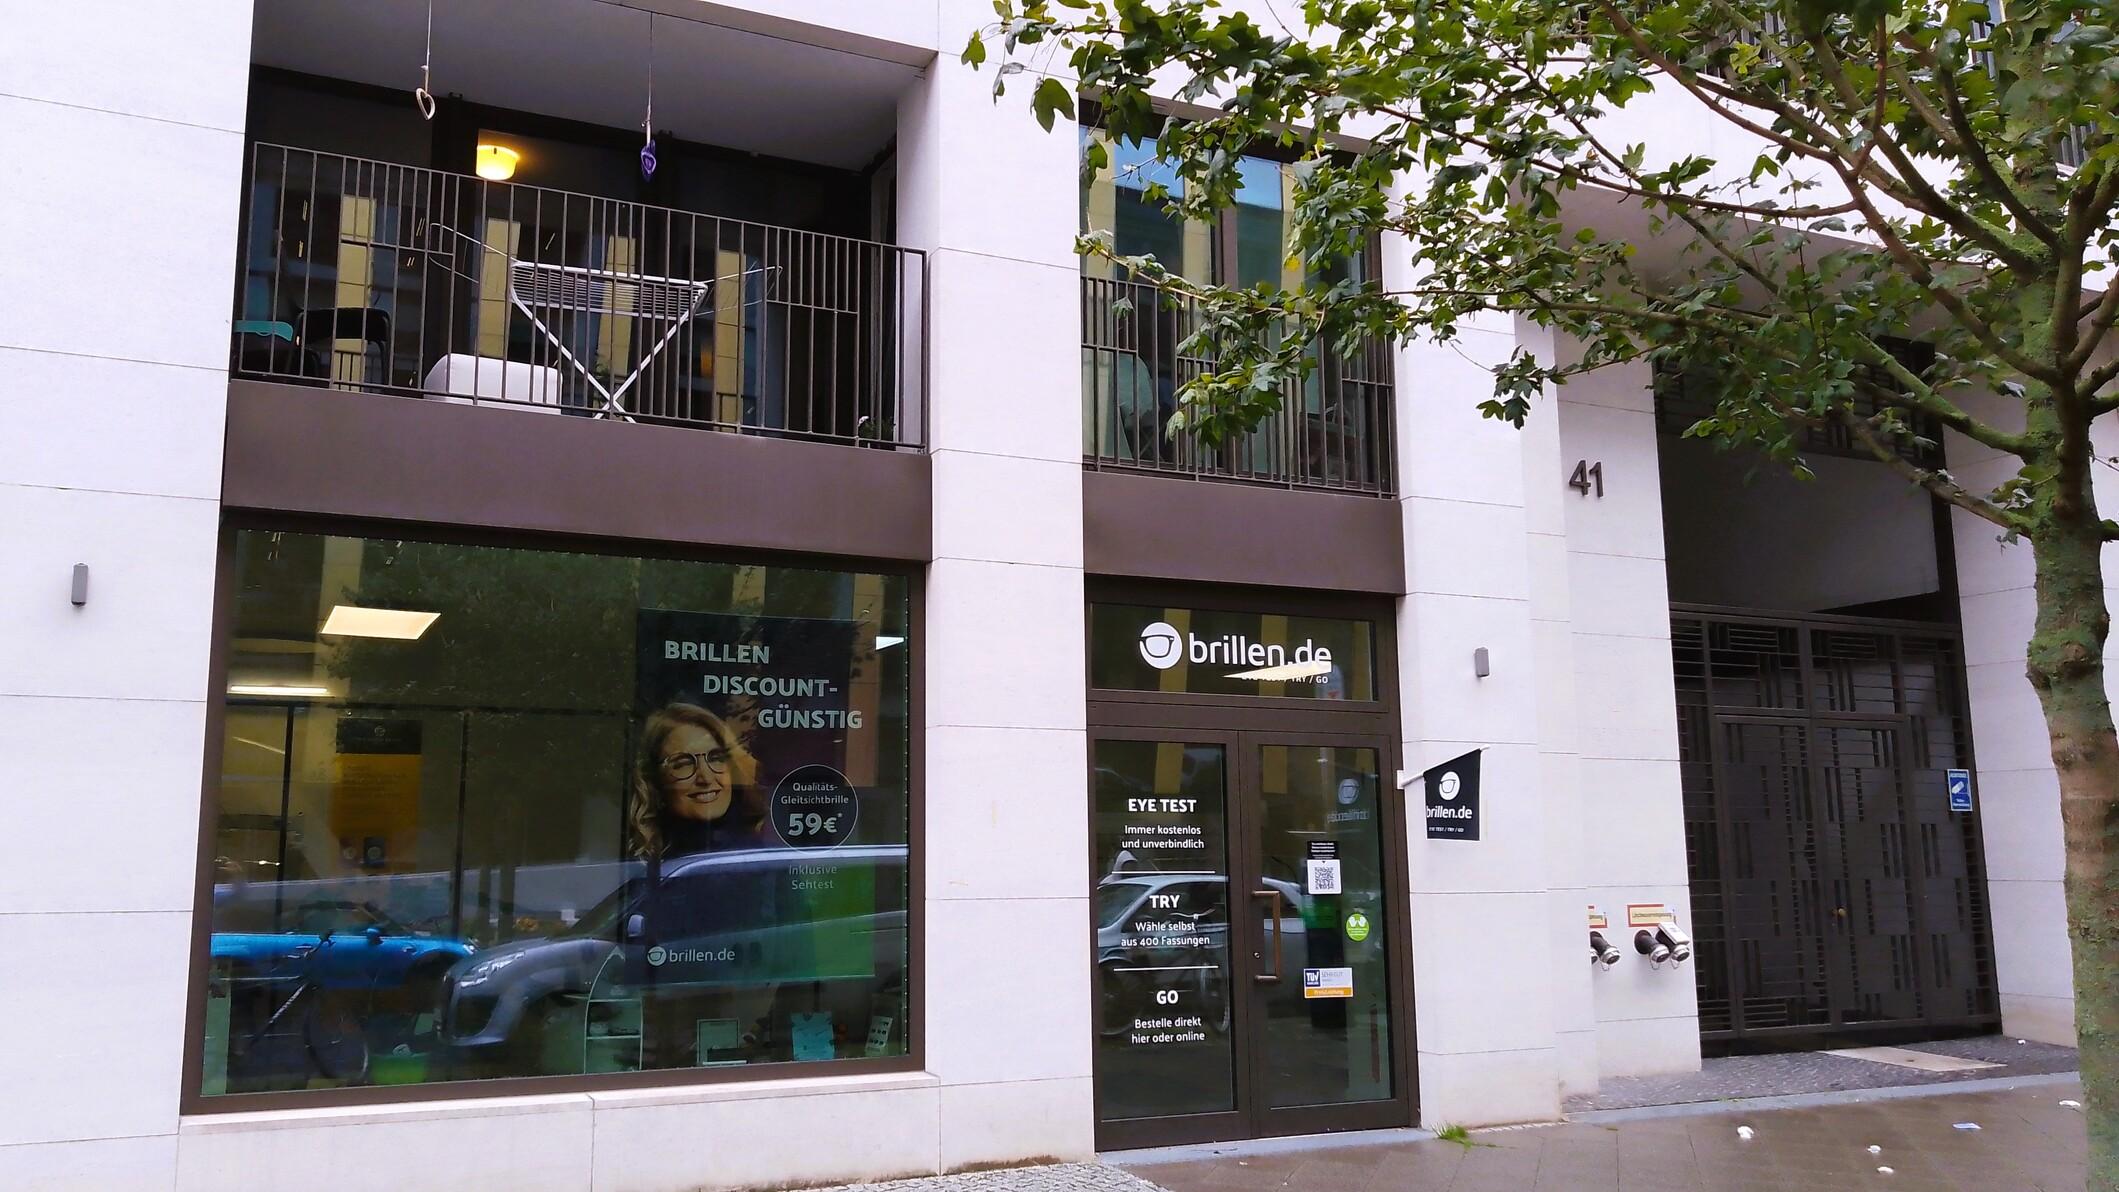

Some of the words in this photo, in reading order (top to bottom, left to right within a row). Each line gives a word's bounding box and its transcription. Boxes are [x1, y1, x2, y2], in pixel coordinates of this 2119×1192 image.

[1569, 459, 1604, 498] 41
[664, 640, 770, 664] BRILLEN
[1188, 632, 1332, 667] brillen.de
[703, 674, 838, 697] DISCOUNT-
[1315, 676, 1329, 684] GO
[758, 703, 863, 729] GÜNSTIG
[792, 782, 838, 792] Qualitäts-
[780, 795, 849, 805] Gleitsichtbrille
[1128, 798, 1157, 812] EYE
[1160, 799, 1197, 813] TEST
[1426, 805, 1473, 819] brillen.de
[1124, 824, 1156, 835] Immer
[1157, 824, 1202, 835] kostenlos
[1121, 838, 1140, 849] und
[1142, 838, 1205, 849] unverbindlich
[791, 879, 834, 890] Sehtest
[1149, 894, 1180, 909] TRY
[1135, 920, 1167, 932] Wähle
[1168, 920, 1196, 931] selbst
[1121, 938, 1138, 947] aus
[1139, 937, 1159, 947] 400
[1161, 935, 1210, 948] Fassungen
[669, 947, 736, 962] brillen.de
[1156, 989, 1179, 1005] GO
[1134, 1017, 1173, 1029] Bestelle
[1174, 1016, 1202, 1027] direkt
[1131, 1033, 1151, 1044] hier
[1152, 1032, 1175, 1043] oder
[1176, 1030, 1205, 1042] online
